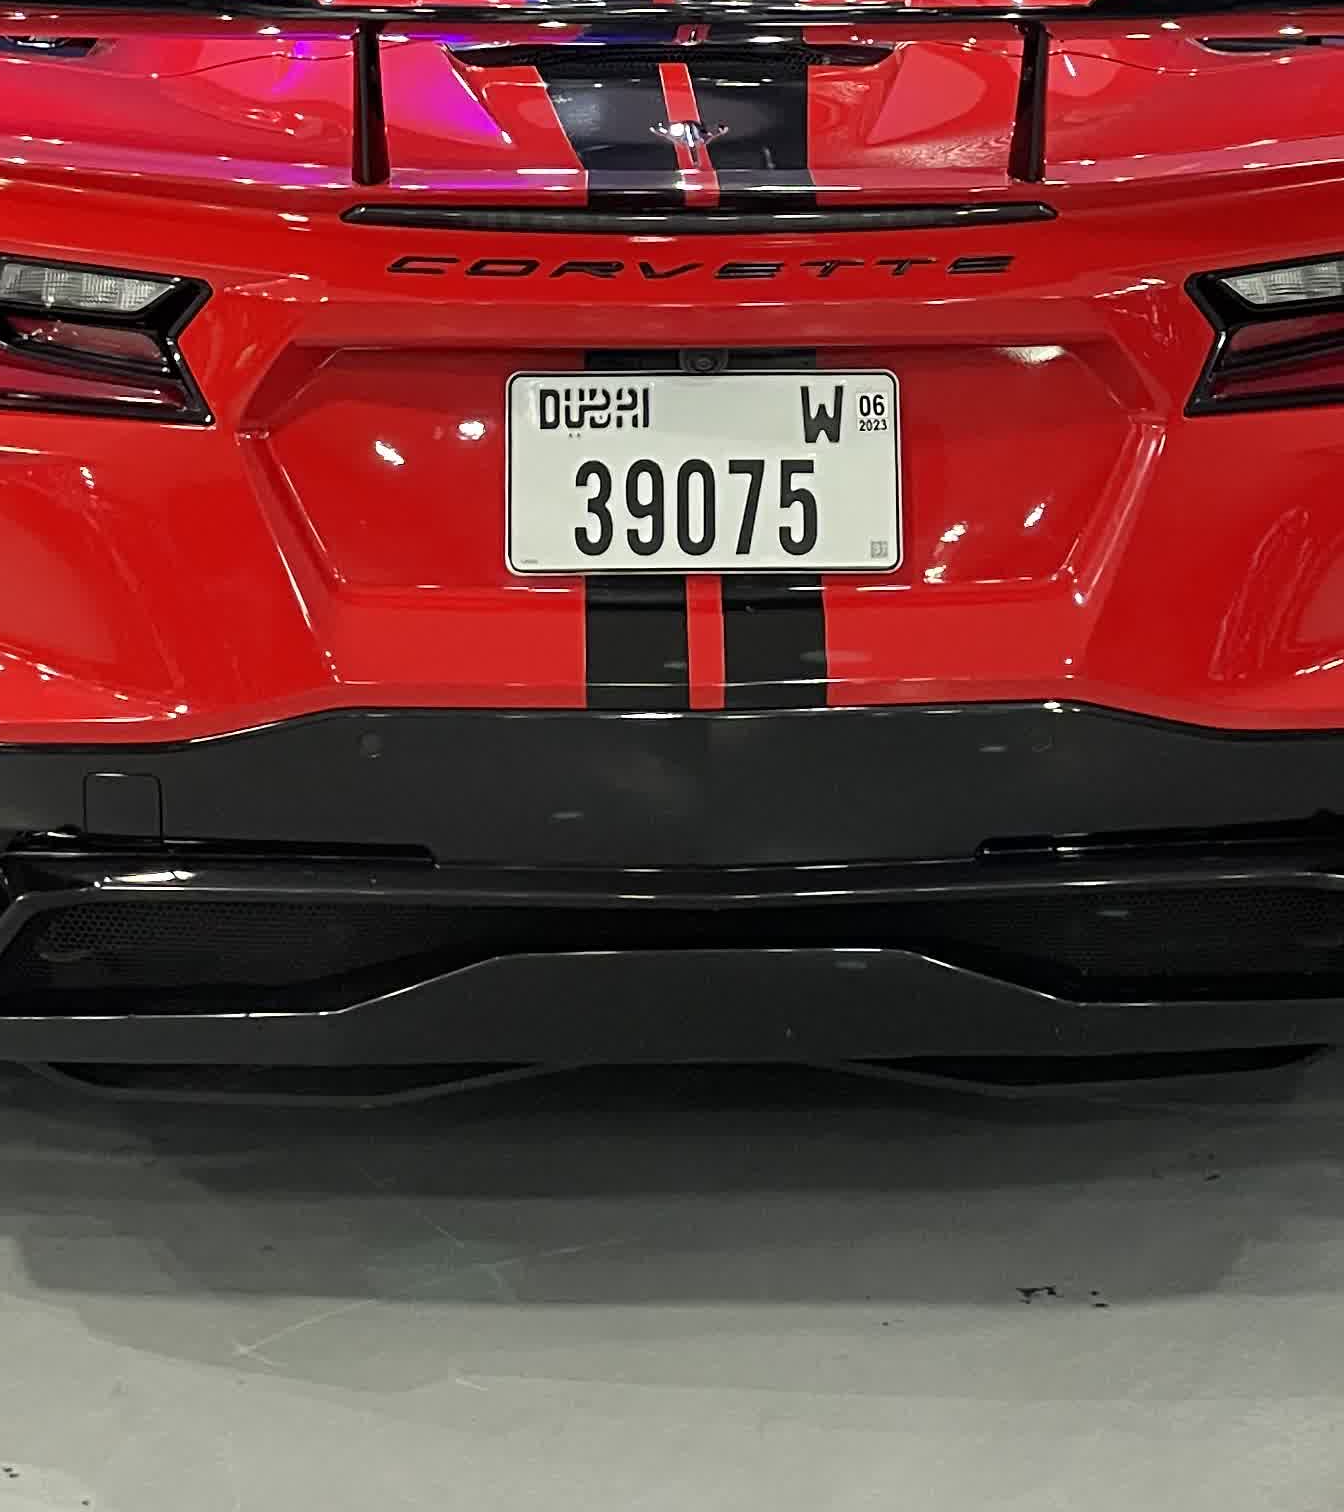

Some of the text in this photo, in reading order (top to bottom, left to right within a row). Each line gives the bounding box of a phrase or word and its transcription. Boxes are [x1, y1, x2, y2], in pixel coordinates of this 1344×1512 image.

[386, 254, 1015, 280] CORVETTE
[800, 385, 844, 444] W
[859, 394, 885, 417] 06
[859, 418, 888, 432] 2023
[574, 458, 818, 557] 39075
